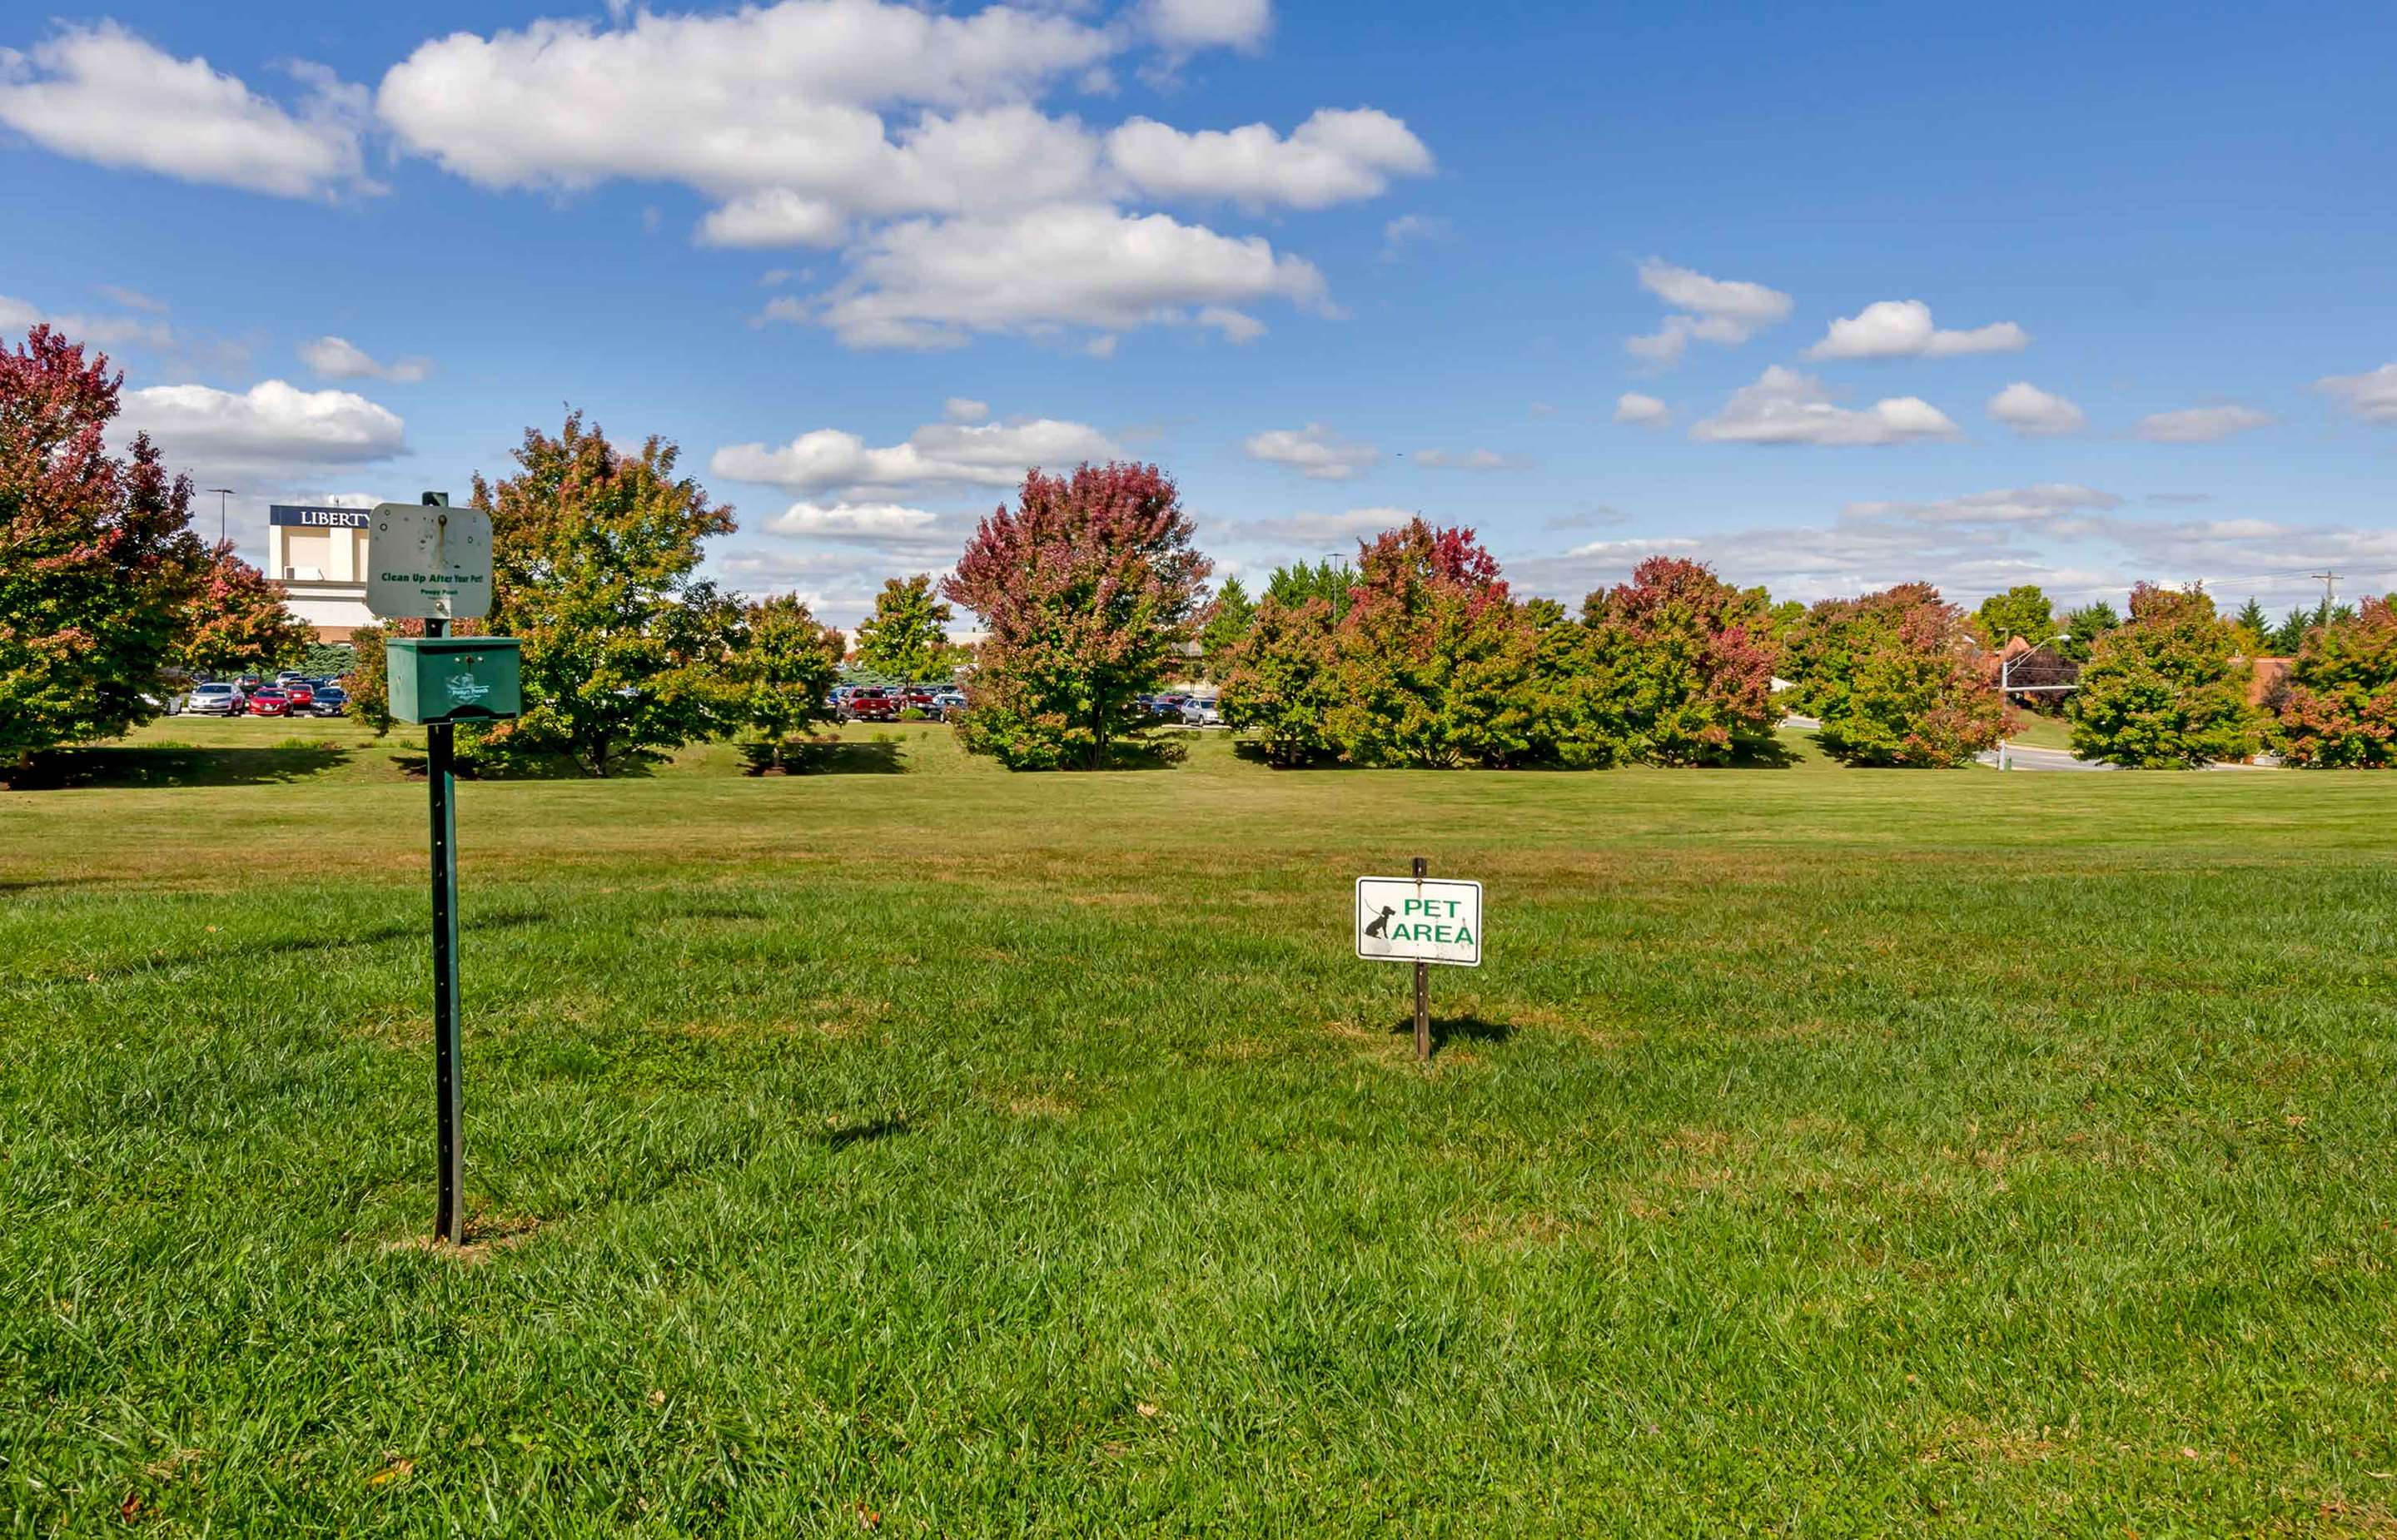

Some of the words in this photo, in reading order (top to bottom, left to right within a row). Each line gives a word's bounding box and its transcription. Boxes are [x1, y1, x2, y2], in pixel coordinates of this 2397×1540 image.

[381, 573, 410, 582] Clean
[412, 574, 426, 584] Up
[429, 574, 453, 583] After
[454, 574, 469, 583] Your
[1404, 899, 1461, 917] PET
[1391, 923, 1474, 944] AREA
